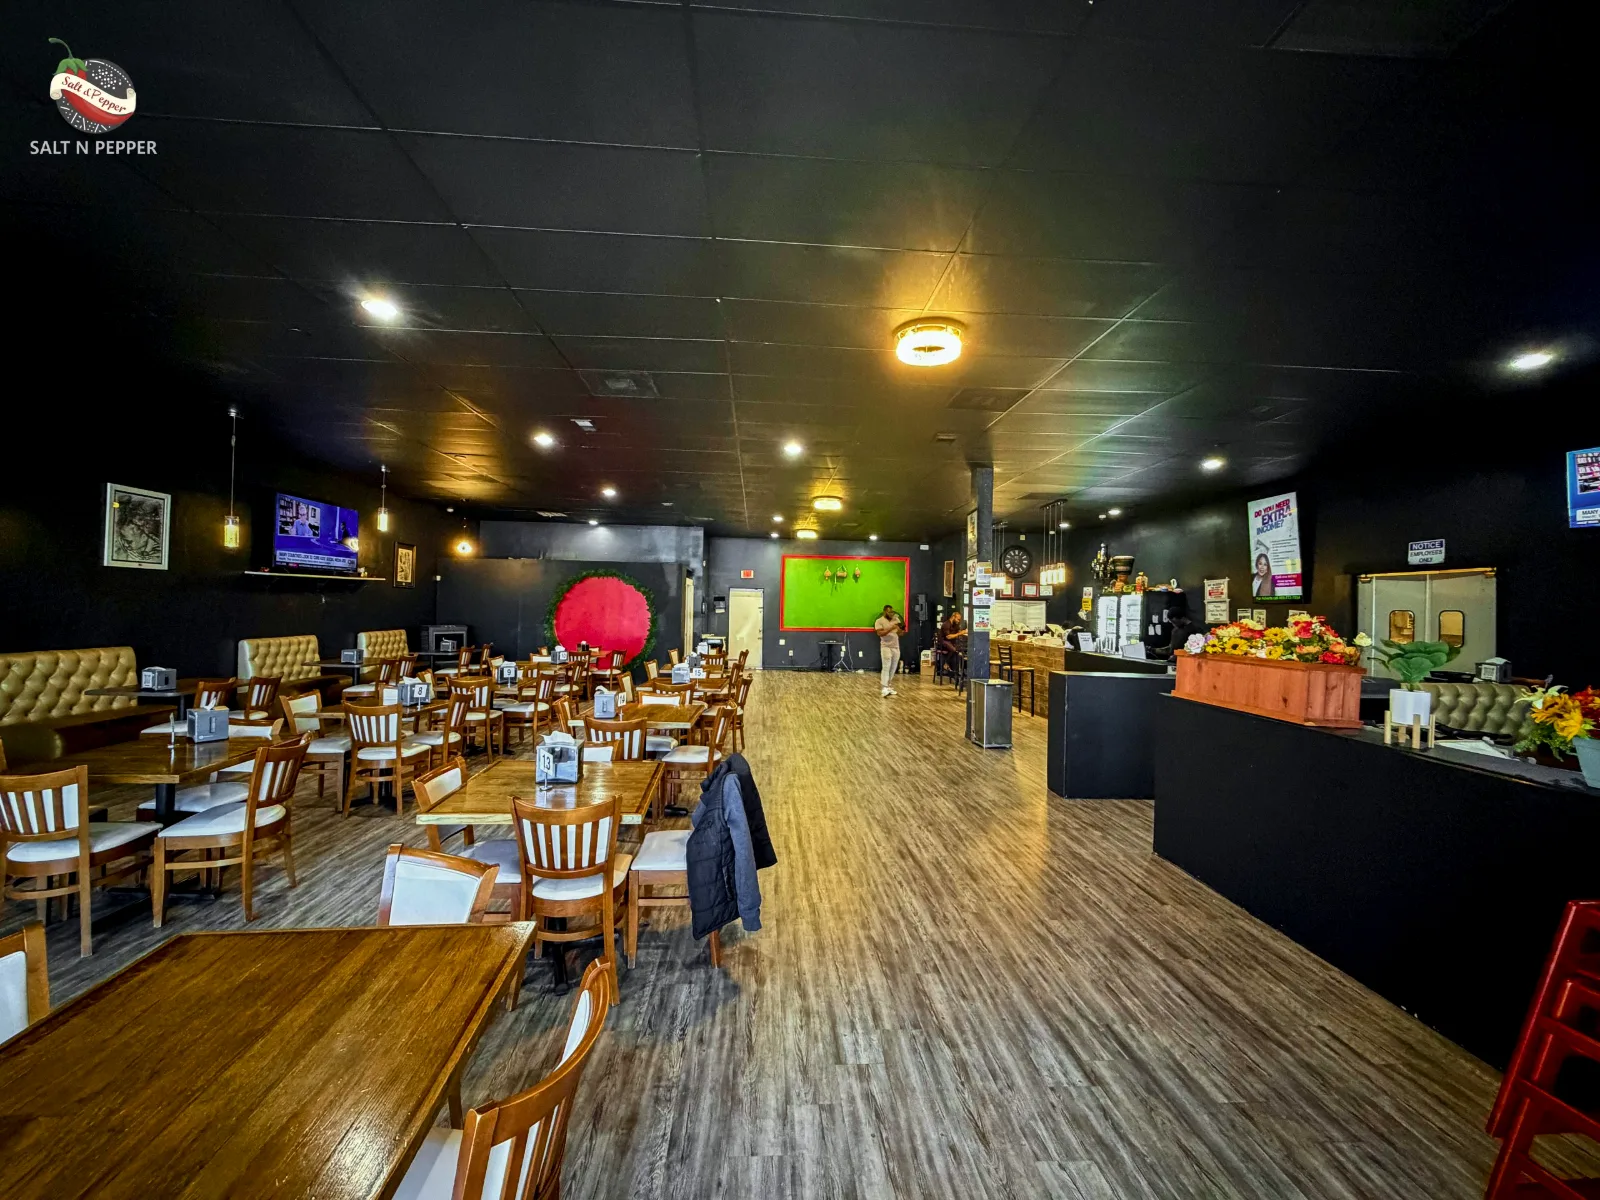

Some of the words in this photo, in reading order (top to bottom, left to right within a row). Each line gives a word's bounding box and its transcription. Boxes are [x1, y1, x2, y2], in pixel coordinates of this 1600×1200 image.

[1254, 510, 1262, 518] DO
[1263, 505, 1274, 514] YOU
[1275, 499, 1290, 509] NEED
[1261, 505, 1292, 526] EXTRA
[1412, 541, 1441, 549] NOTICE
[507, 668, 512, 676] 9
[418, 686, 423, 696] 8
[542, 753, 551, 771] 13
